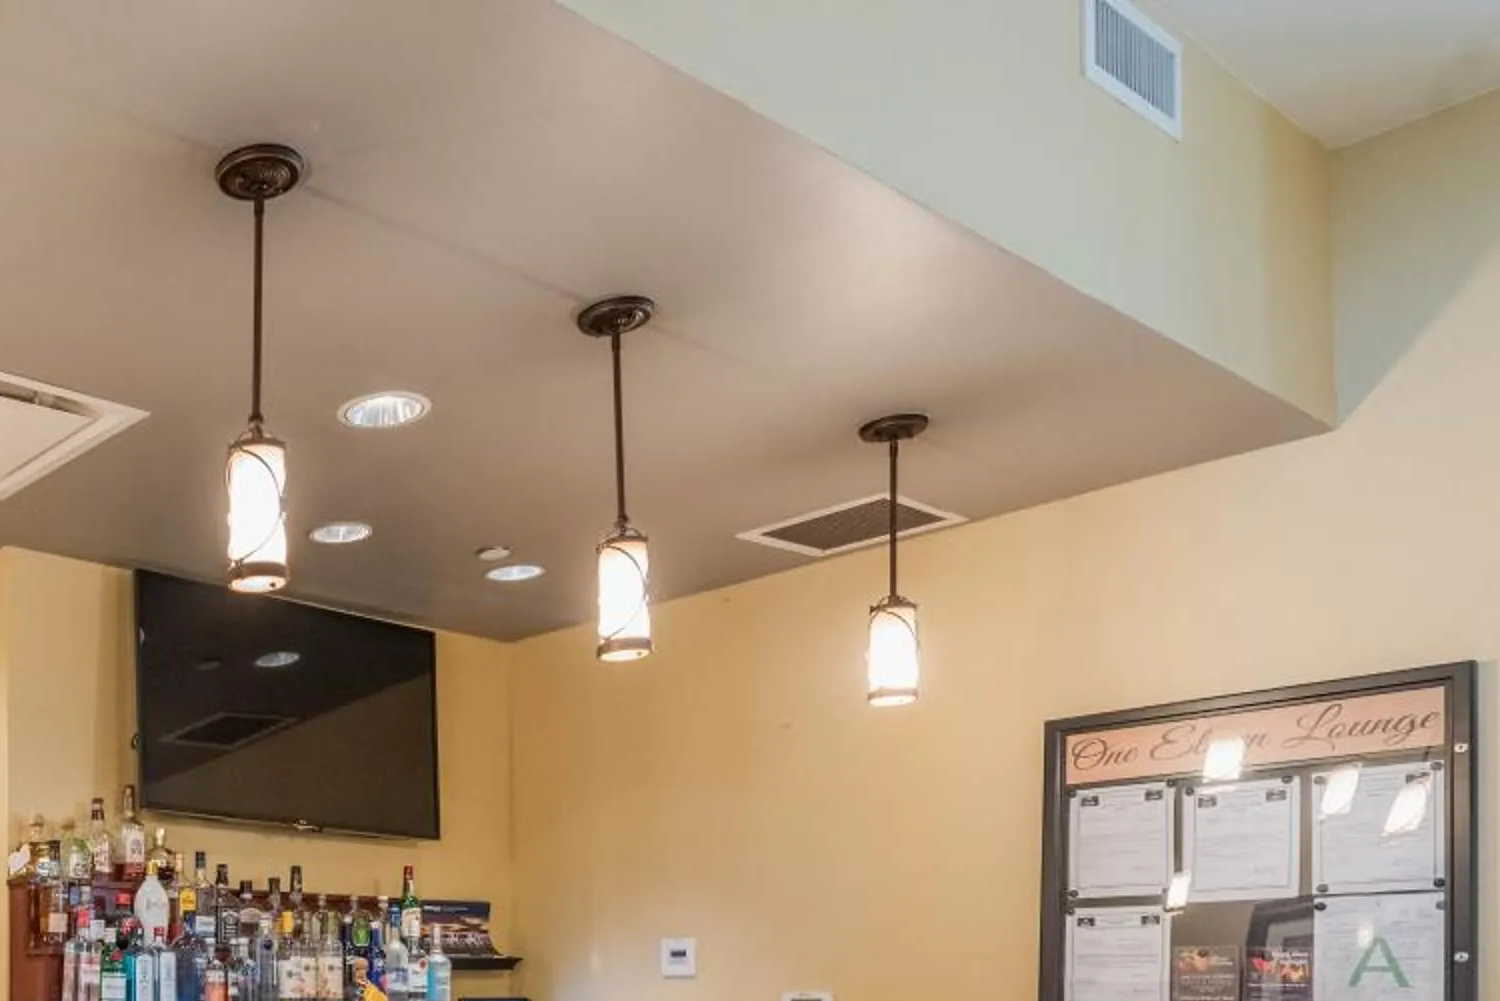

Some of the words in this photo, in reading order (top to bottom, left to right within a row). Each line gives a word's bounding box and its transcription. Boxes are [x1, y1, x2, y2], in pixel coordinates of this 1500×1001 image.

[1071, 736, 1138, 771] One
[1280, 703, 1439, 752] Lounge
[1347, 936, 1411, 989] A
